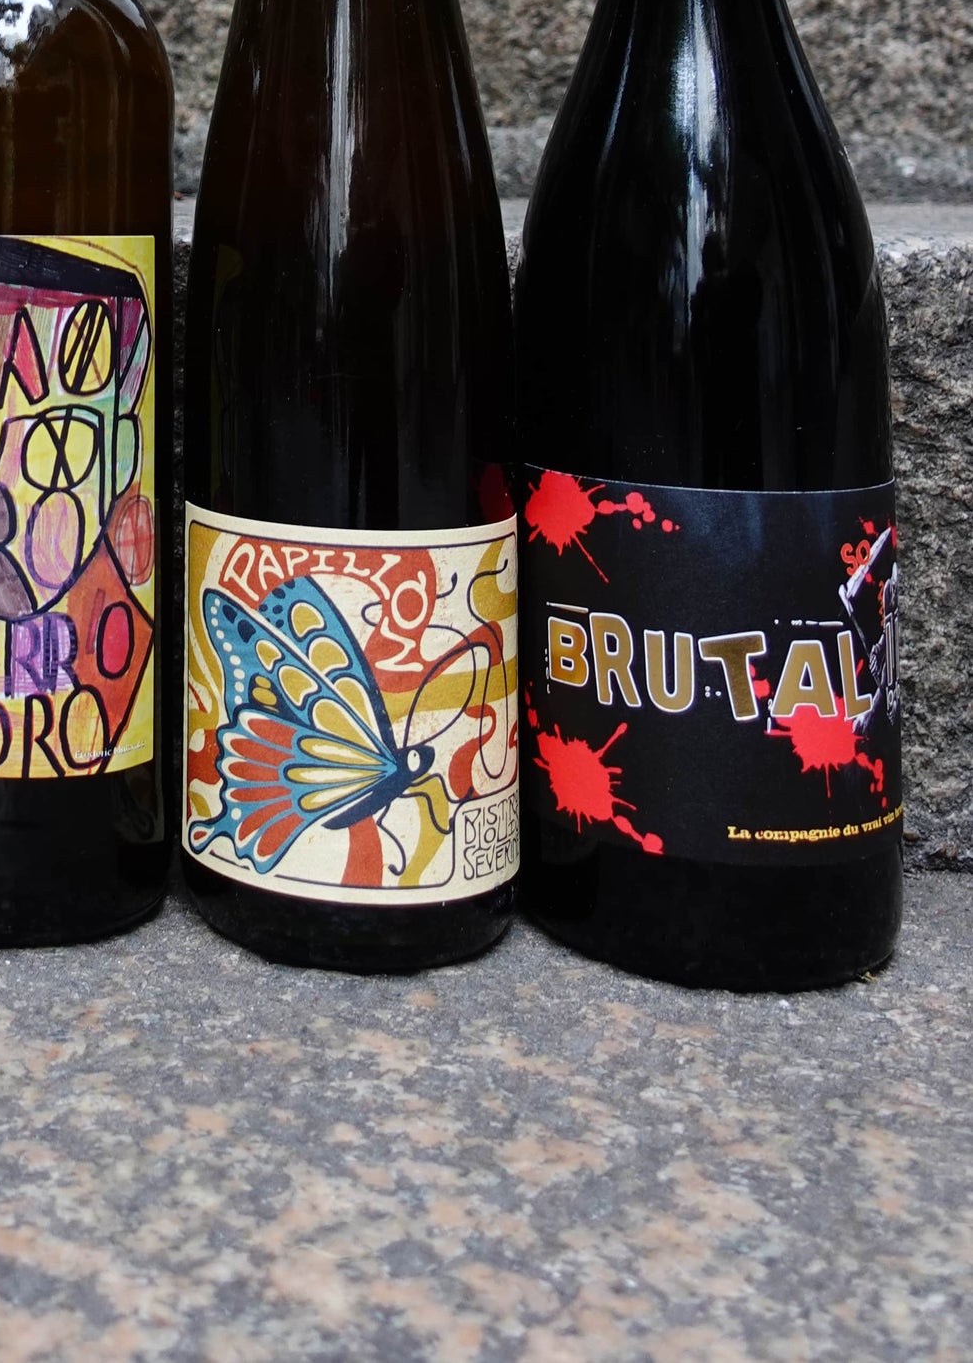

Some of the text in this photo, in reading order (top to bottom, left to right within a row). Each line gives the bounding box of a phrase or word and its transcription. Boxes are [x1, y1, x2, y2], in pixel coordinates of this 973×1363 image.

[223, 541, 428, 672] PAPILLON
[547, 611, 874, 722] BRUTAL
[727, 826, 751, 839] La
[755, 825, 840, 842] compagnie
[843, 824, 859, 837] du
